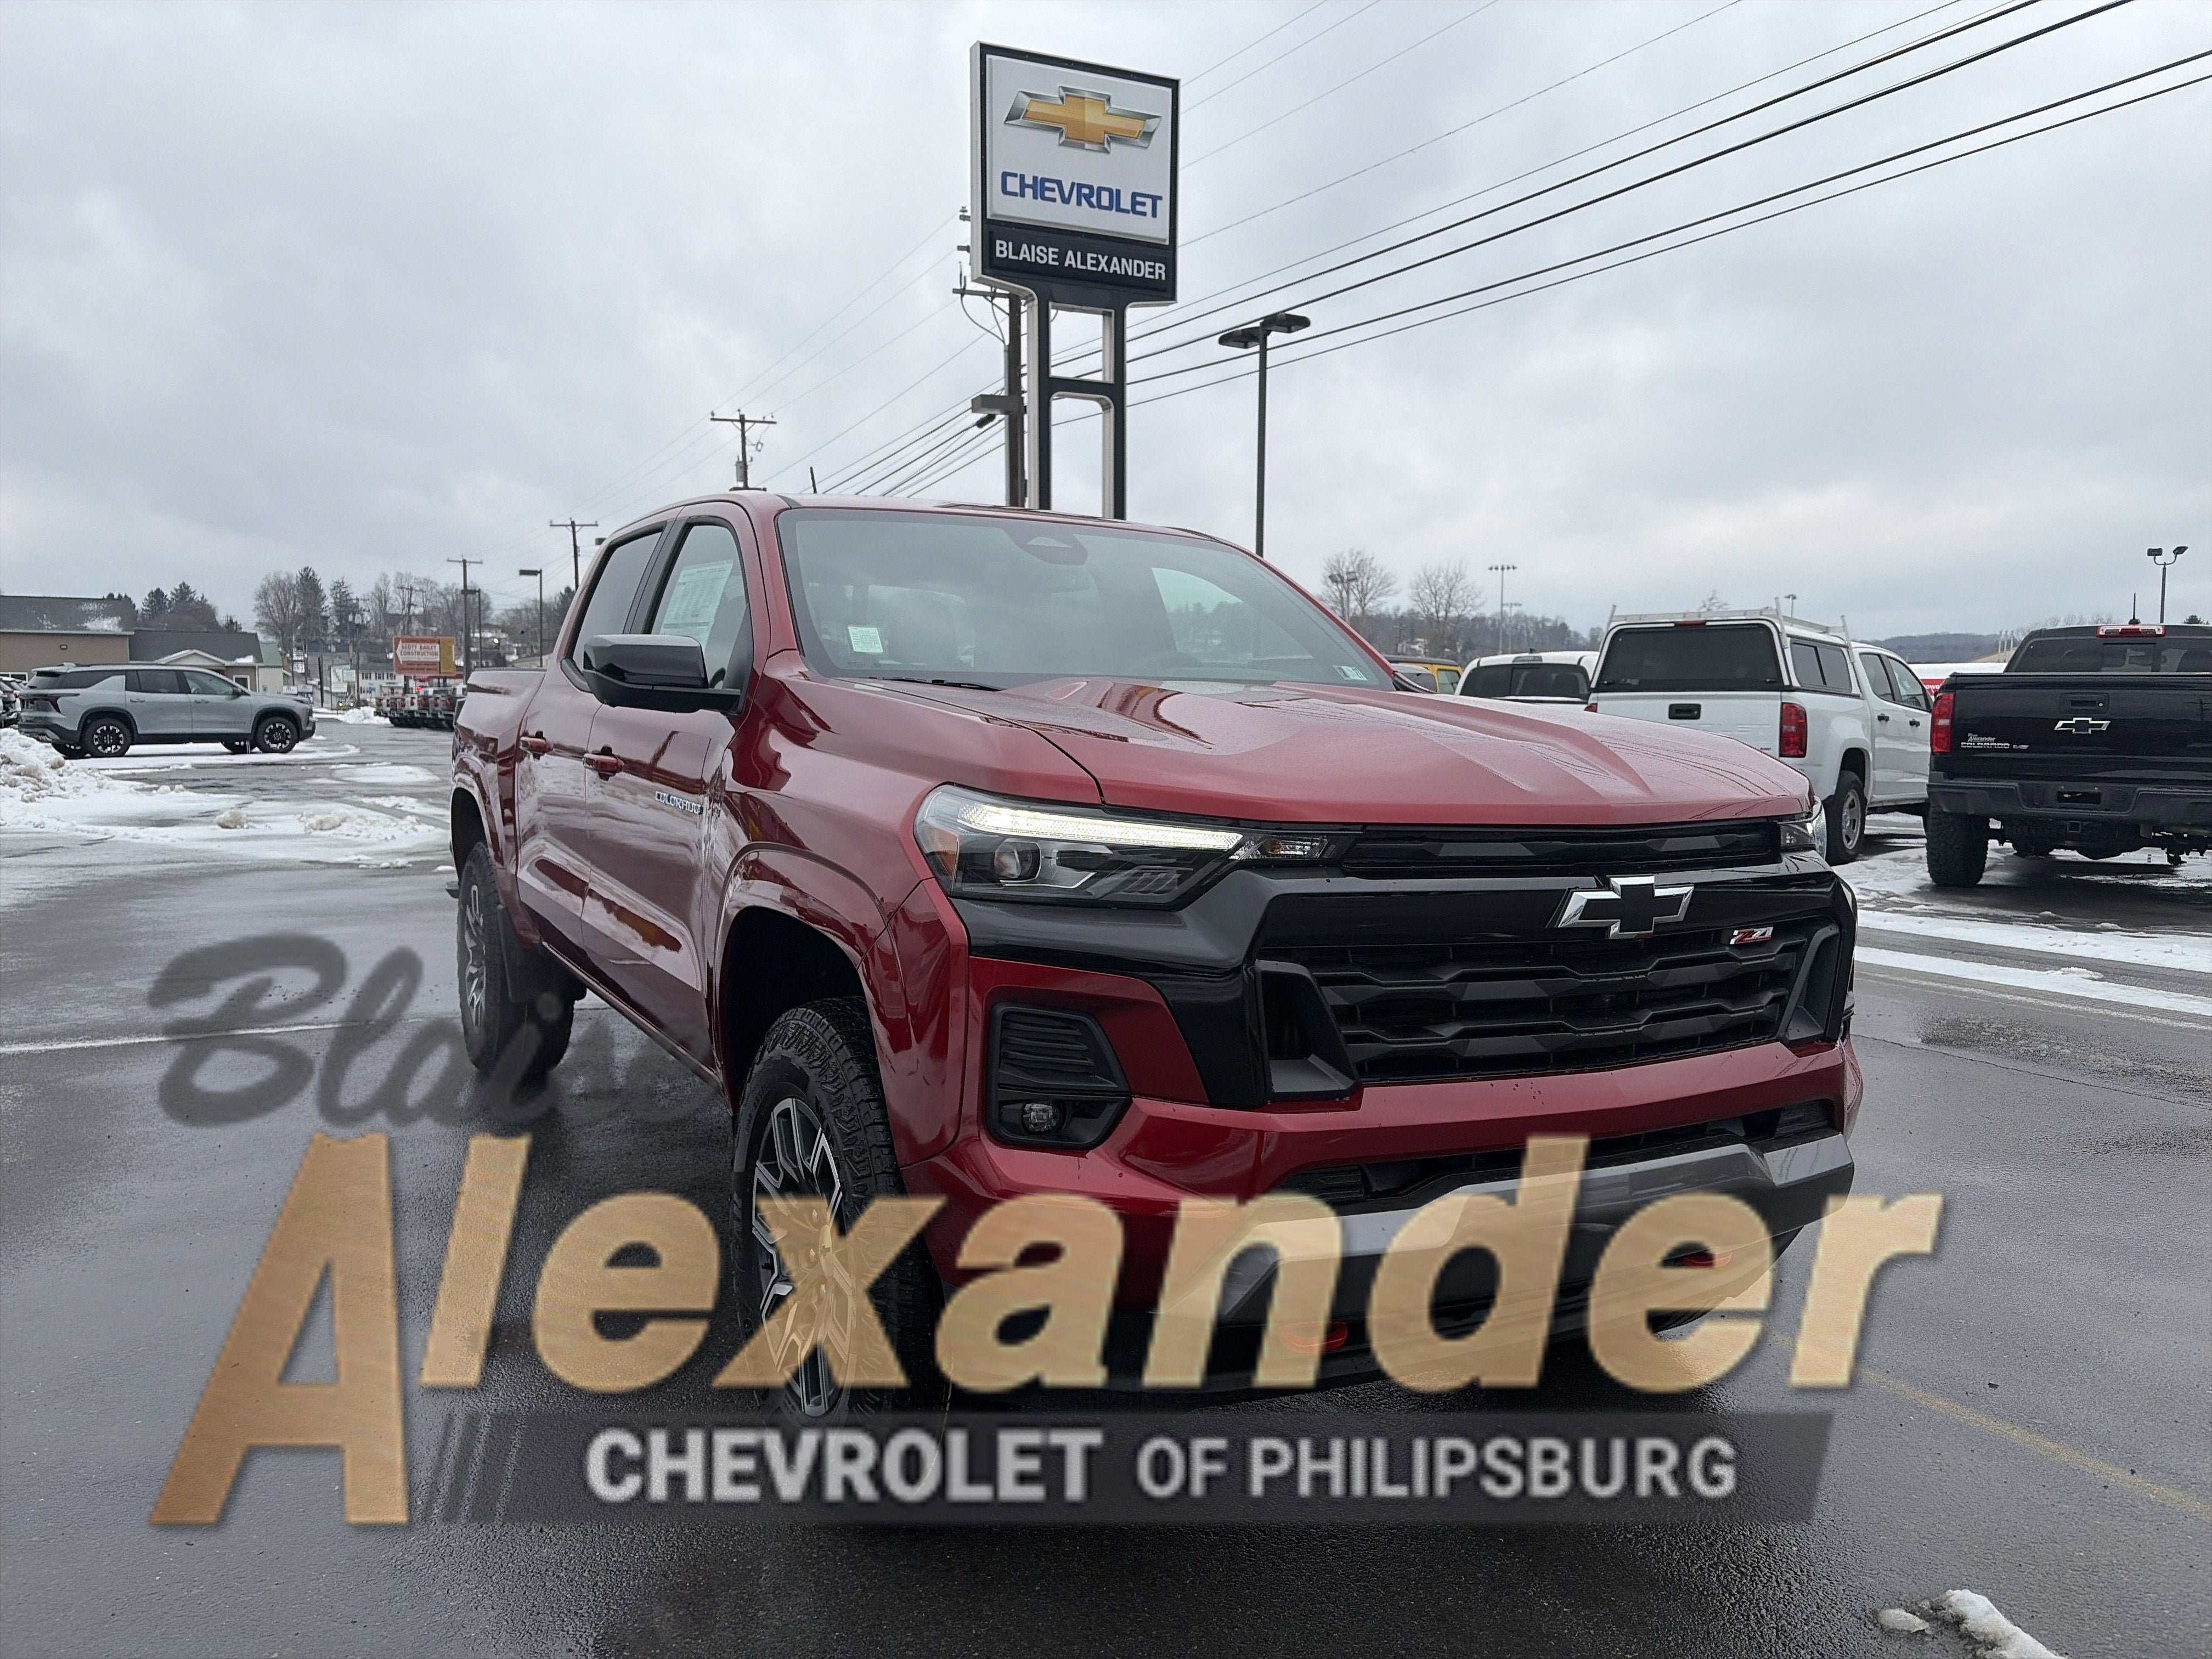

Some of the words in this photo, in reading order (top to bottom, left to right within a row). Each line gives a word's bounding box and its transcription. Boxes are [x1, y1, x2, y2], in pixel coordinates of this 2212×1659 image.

[1001, 171, 1163, 218] CHEVROLET
[995, 239, 1059, 266] BLAISE
[1064, 249, 1166, 281] ALEXANDER
[655, 791, 704, 815] COLORADO
[1729, 926, 1774, 945] Z71
